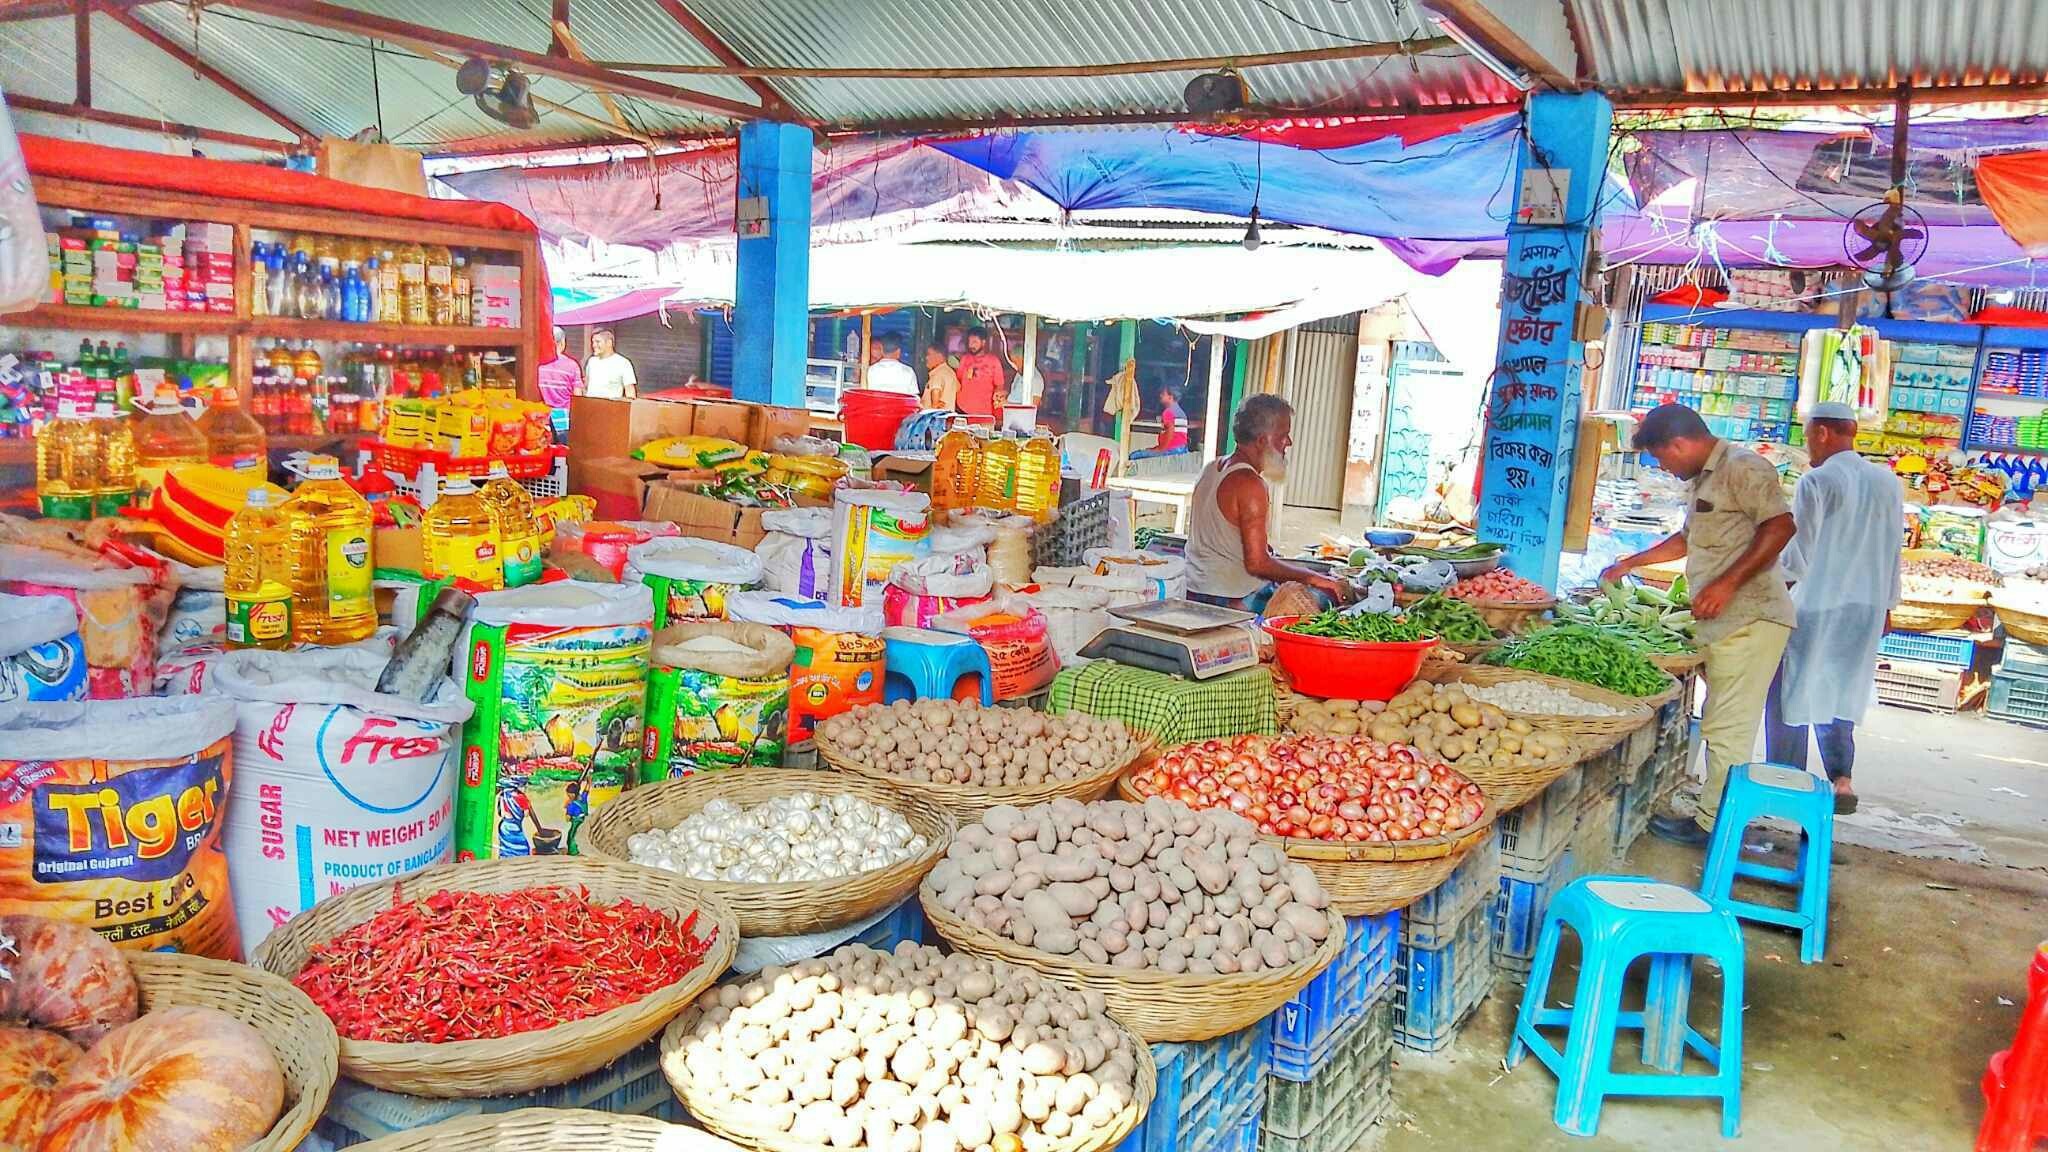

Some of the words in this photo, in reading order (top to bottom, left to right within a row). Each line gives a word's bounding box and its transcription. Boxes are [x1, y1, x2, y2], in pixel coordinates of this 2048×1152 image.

[1505, 316, 1562, 346] স্টোর
[1528, 442, 1553, 469] করা
[49, 776, 218, 858] Tiger
[259, 784, 286, 860] SUGAR
[324, 828, 360, 848] NET
[366, 820, 425, 848] WEIGHT
[428, 809, 440, 831] 50
[38, 860, 88, 873] Original
[90, 855, 134, 869] Gujarat
[324, 862, 384, 878] PRODUCT
[387, 860, 401, 875] OF
[95, 892, 154, 919] Best
